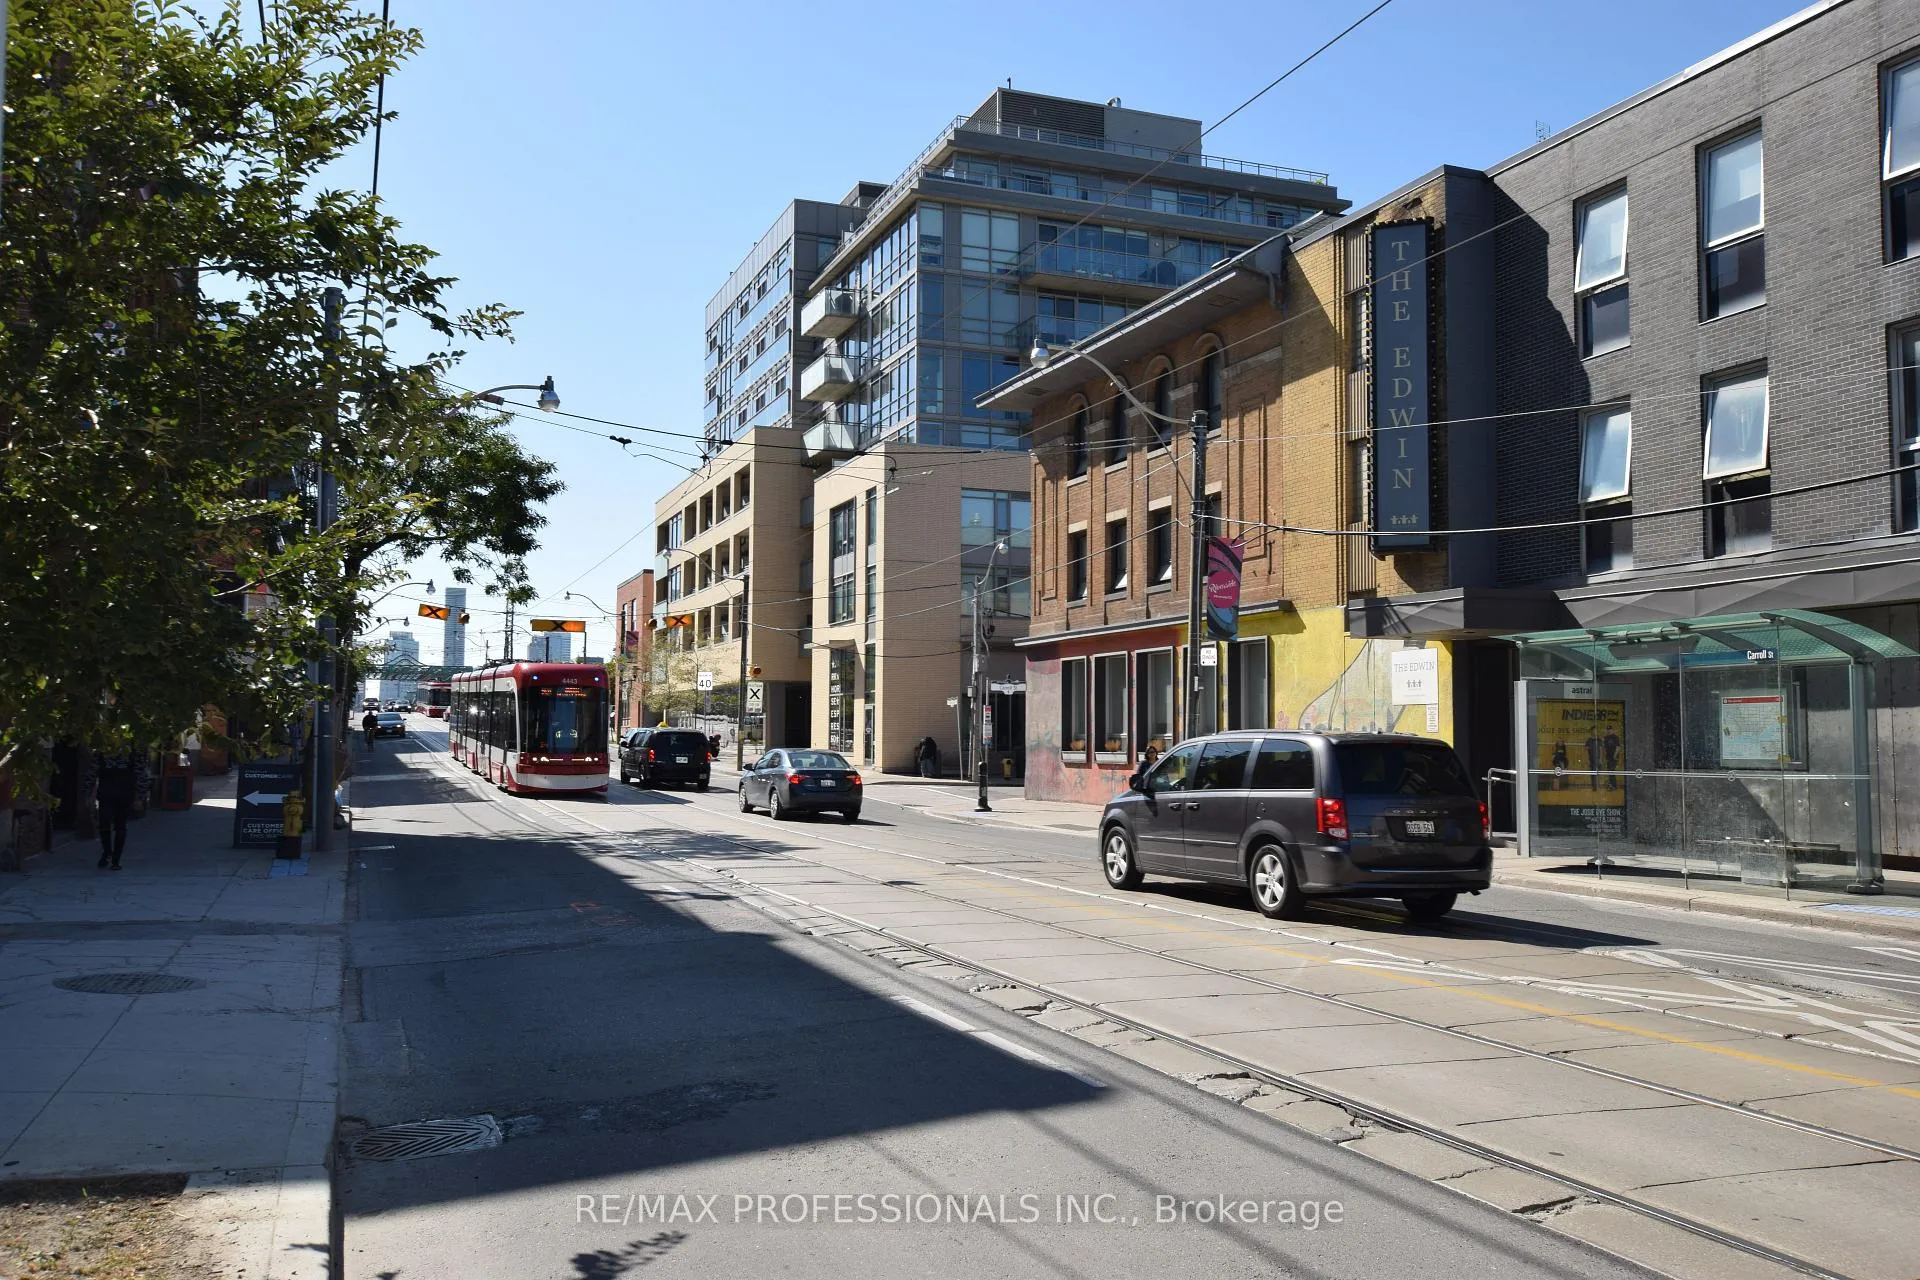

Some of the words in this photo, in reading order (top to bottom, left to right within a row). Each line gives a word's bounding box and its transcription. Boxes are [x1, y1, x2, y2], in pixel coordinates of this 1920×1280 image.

[1391, 240, 1412, 322] THE
[1388, 346, 1417, 489] EDWIN
[1747, 650, 1767, 660] Carroll
[1394, 663, 1408, 672] THE
[1409, 661, 1434, 672] EDWIN
[698, 679, 712, 688] 40
[1570, 808, 1580, 816] THE
[1606, 808, 1621, 816] SHOW
